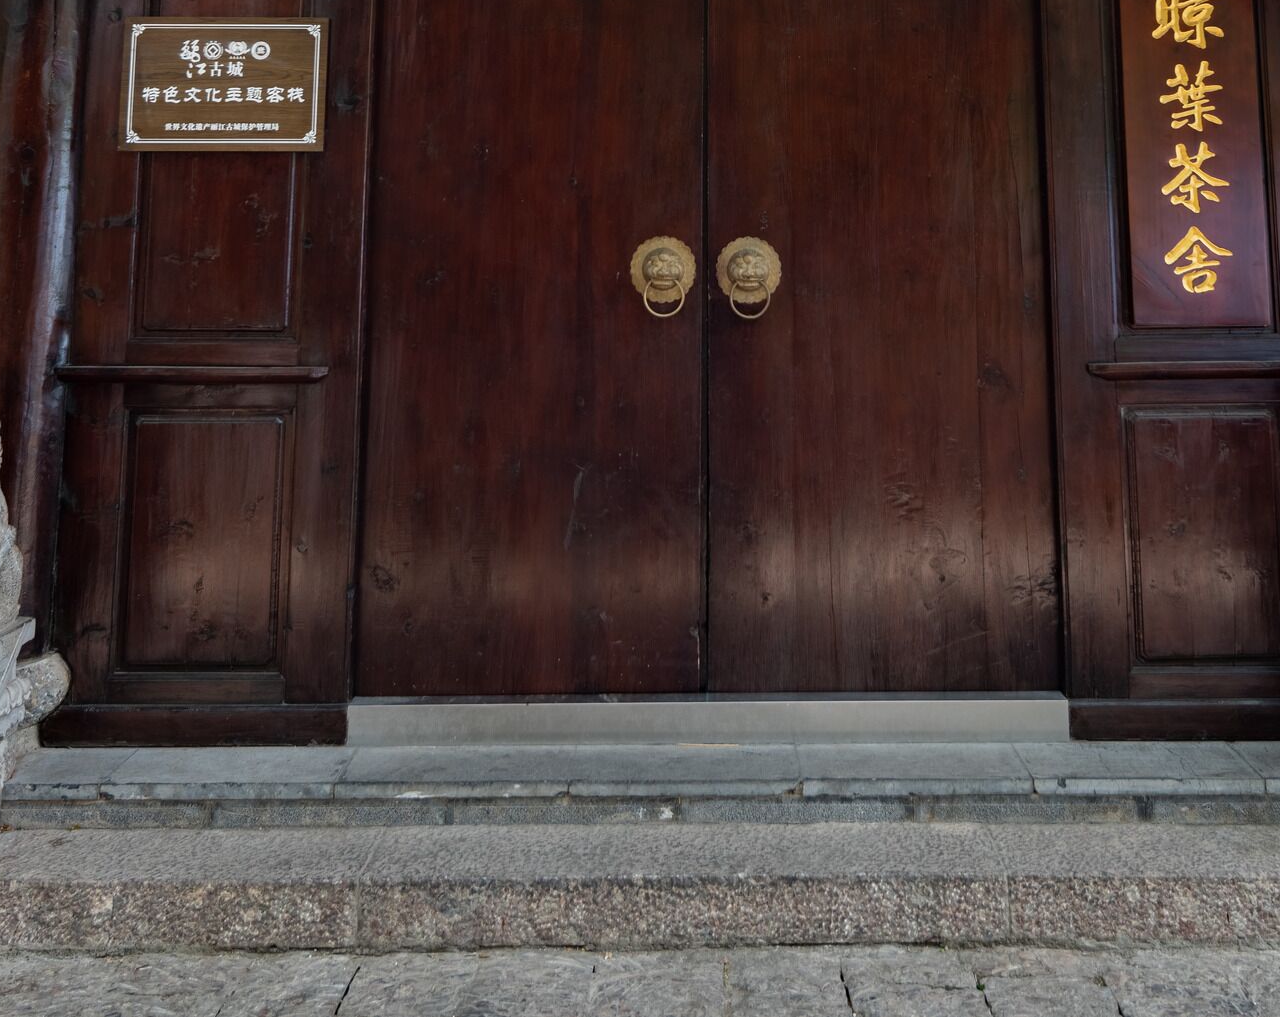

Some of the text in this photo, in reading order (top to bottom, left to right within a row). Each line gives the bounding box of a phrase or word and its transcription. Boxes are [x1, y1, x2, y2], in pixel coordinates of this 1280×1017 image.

[142, 86, 306, 104] 特色文化主题客栈
[164, 122, 280, 132] 世界文化遗产丽江古城保护管理局
